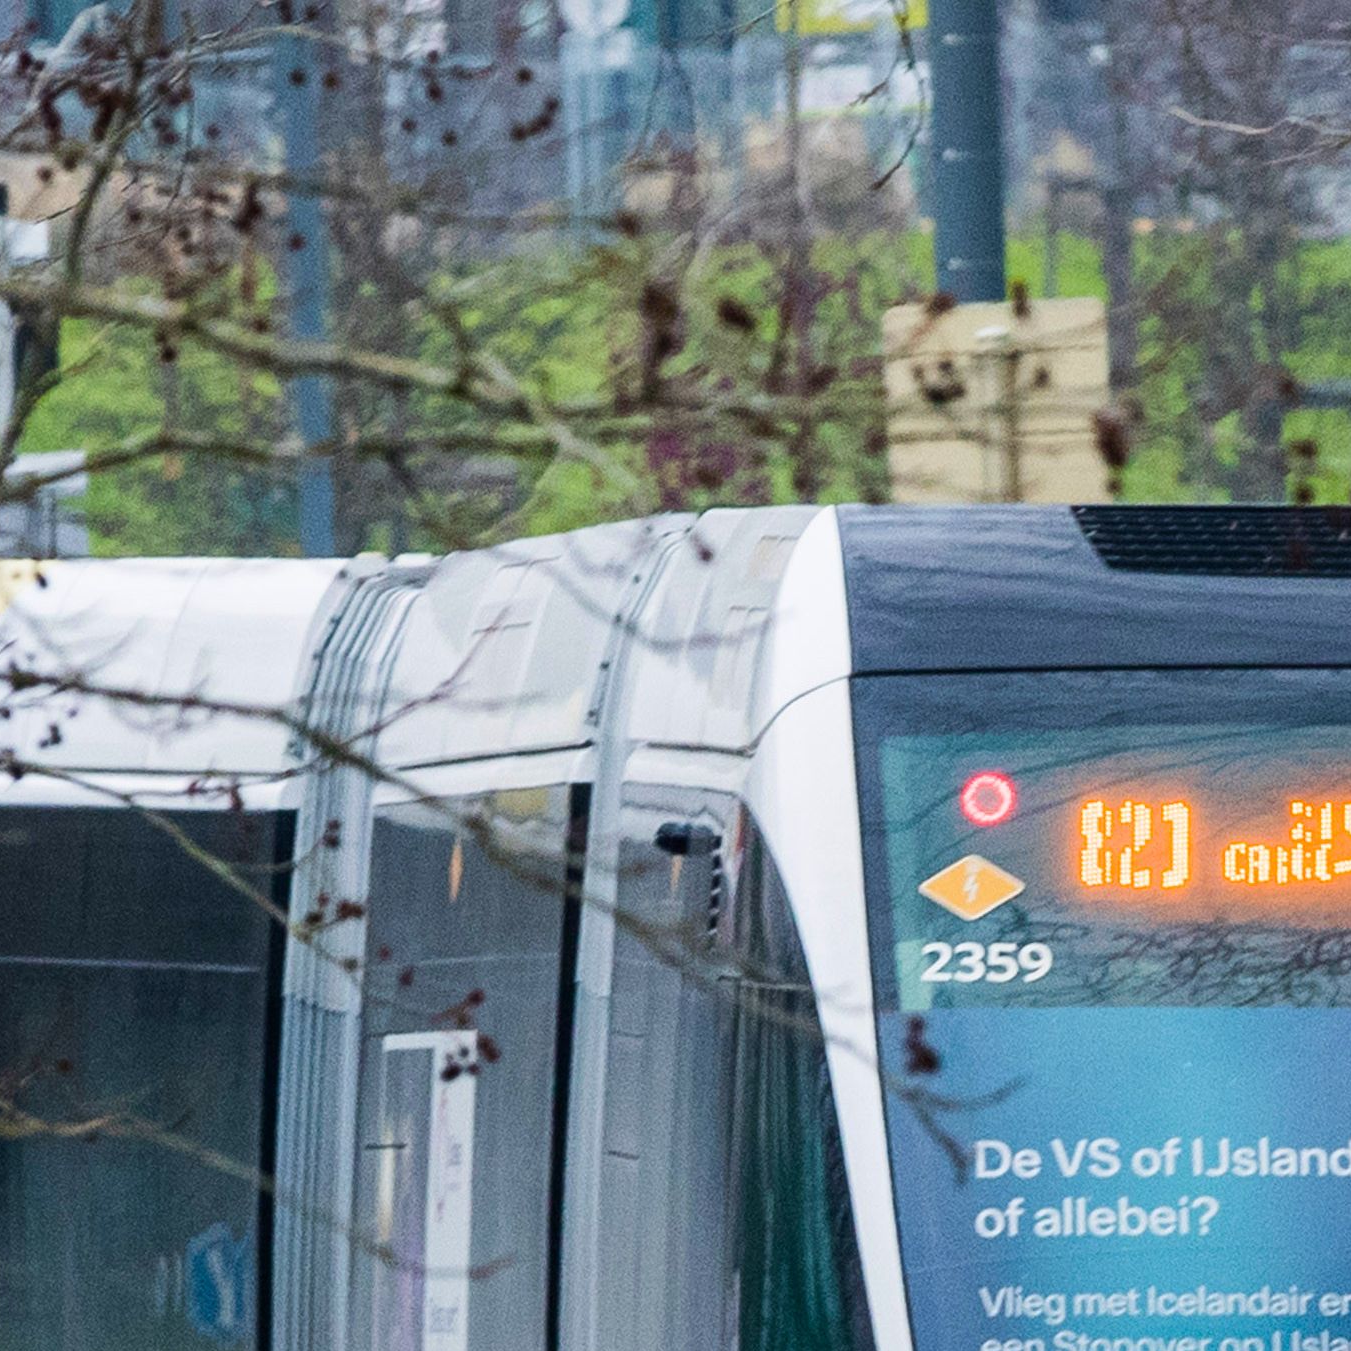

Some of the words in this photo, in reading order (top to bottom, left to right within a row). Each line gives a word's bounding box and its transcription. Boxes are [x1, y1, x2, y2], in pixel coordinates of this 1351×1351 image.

[920, 941, 1053, 983] 2359
[974, 1139, 1042, 1179] De
[1050, 1138, 1121, 1178] VS
[1131, 1137, 1182, 1177] of
[974, 1198, 1025, 1238] of
[1033, 1196, 1220, 1238] allebei?
[979, 1286, 1066, 1325] Vlieg
[1073, 1287, 1140, 1318] met
[1147, 1285, 1314, 1318] Icelandair
